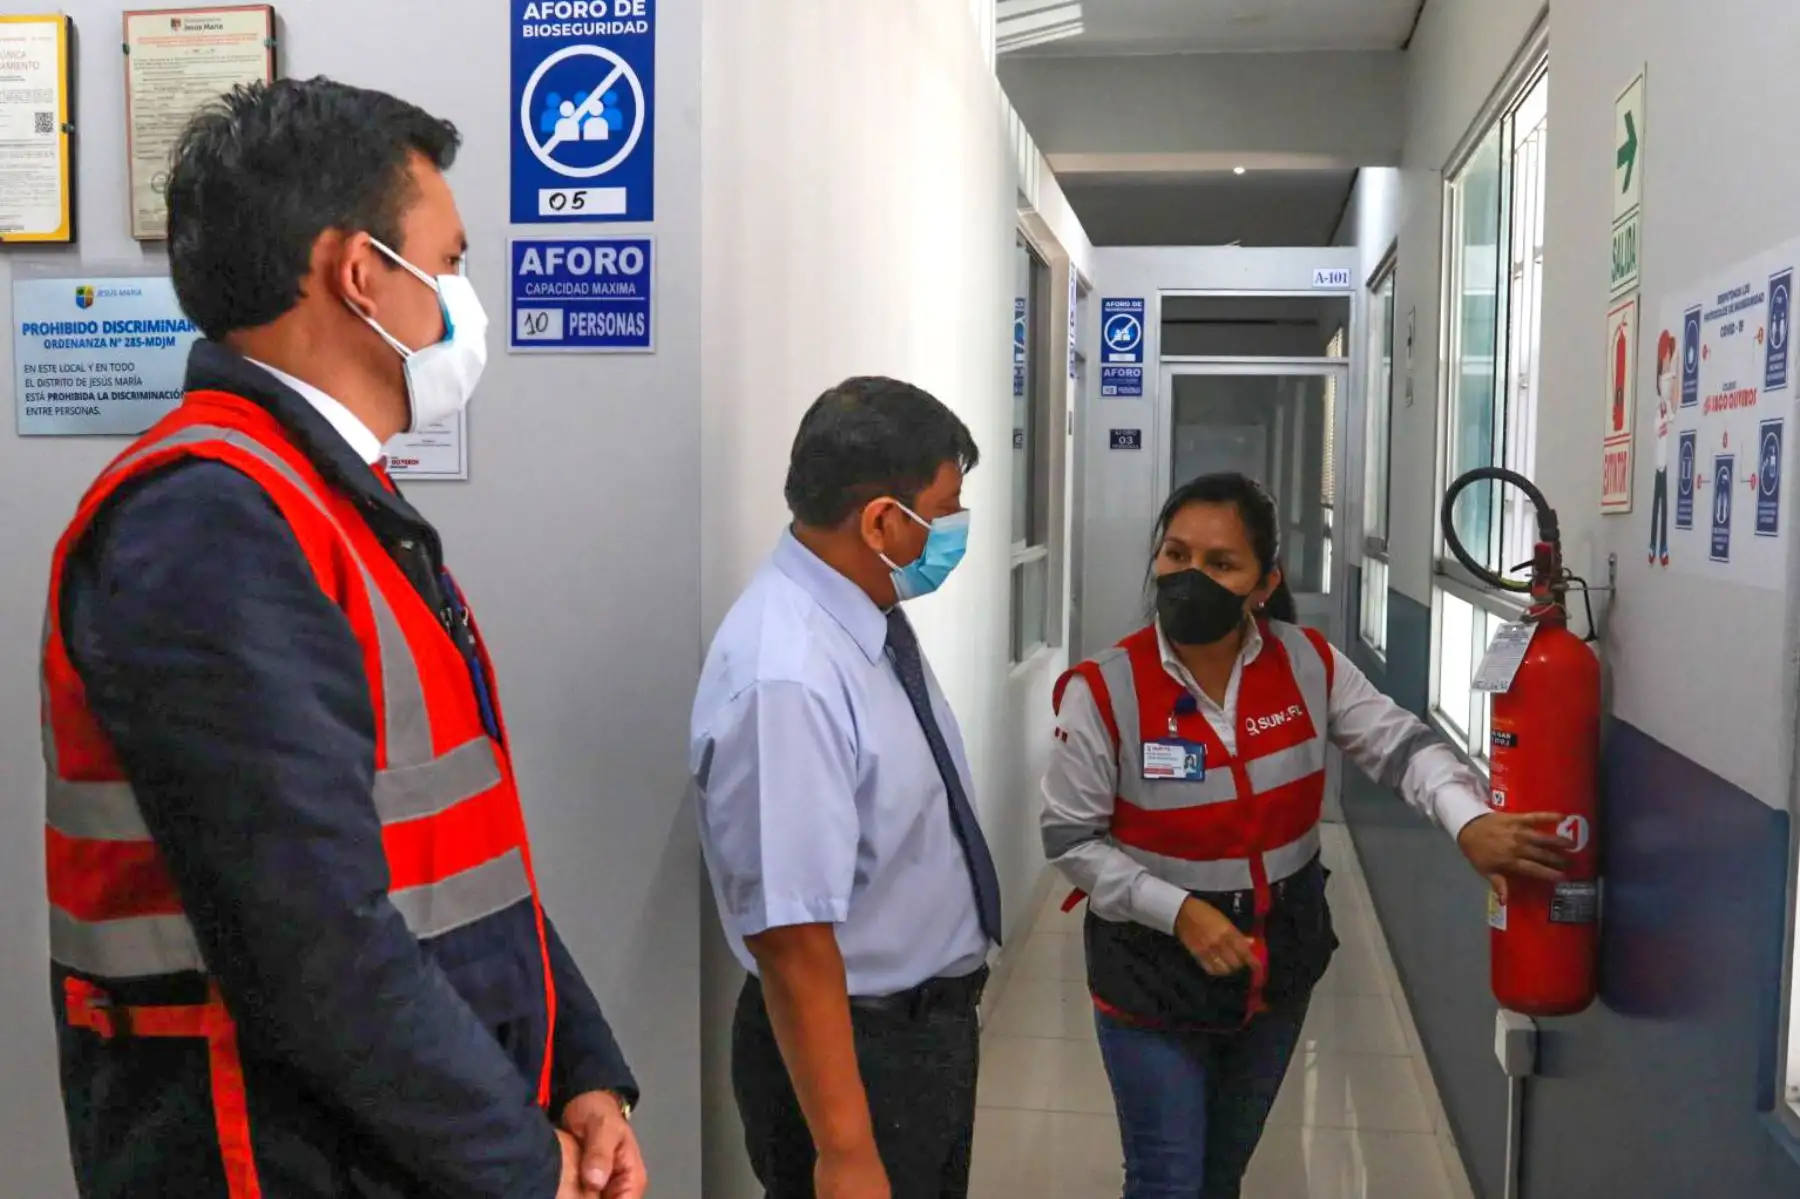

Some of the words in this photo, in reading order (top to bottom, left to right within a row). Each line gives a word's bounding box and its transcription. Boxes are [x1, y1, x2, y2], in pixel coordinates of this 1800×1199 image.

[523, 0, 607, 20] AFORO
[614, 0, 646, 16] DE
[522, 20, 648, 37] BIOSEGURIDAD
[549, 191, 587, 211] 05
[1612, 222, 1636, 282] SALIDA
[518, 246, 644, 275] AFORO
[1314, 271, 1348, 284] A-101
[525, 282, 589, 295] CAPACIDAD
[591, 282, 636, 294] MAXIMA
[22, 321, 98, 336] PROHIBIDO
[524, 312, 549, 335] 10
[569, 312, 645, 336] PERSONAS
[44, 338, 107, 350] ORDENANZA
[124, 336, 176, 349] 285-MDJM
[24, 364, 36, 373] EN
[38, 364, 57, 373] ESTE
[59, 363, 86, 373] LOCAL
[95, 363, 108, 372] EN
[110, 362, 135, 372] TODO
[1104, 367, 1141, 377] AFORO
[25, 379, 35, 388] EL
[37, 378, 74, 388] DISTRITO
[75, 377, 87, 387] DE
[47, 392, 95, 401] PROHIBIDA
[97, 392, 109, 400] LA
[26, 406, 54, 416] ENTRE
[1118, 436, 1134, 445] 03
